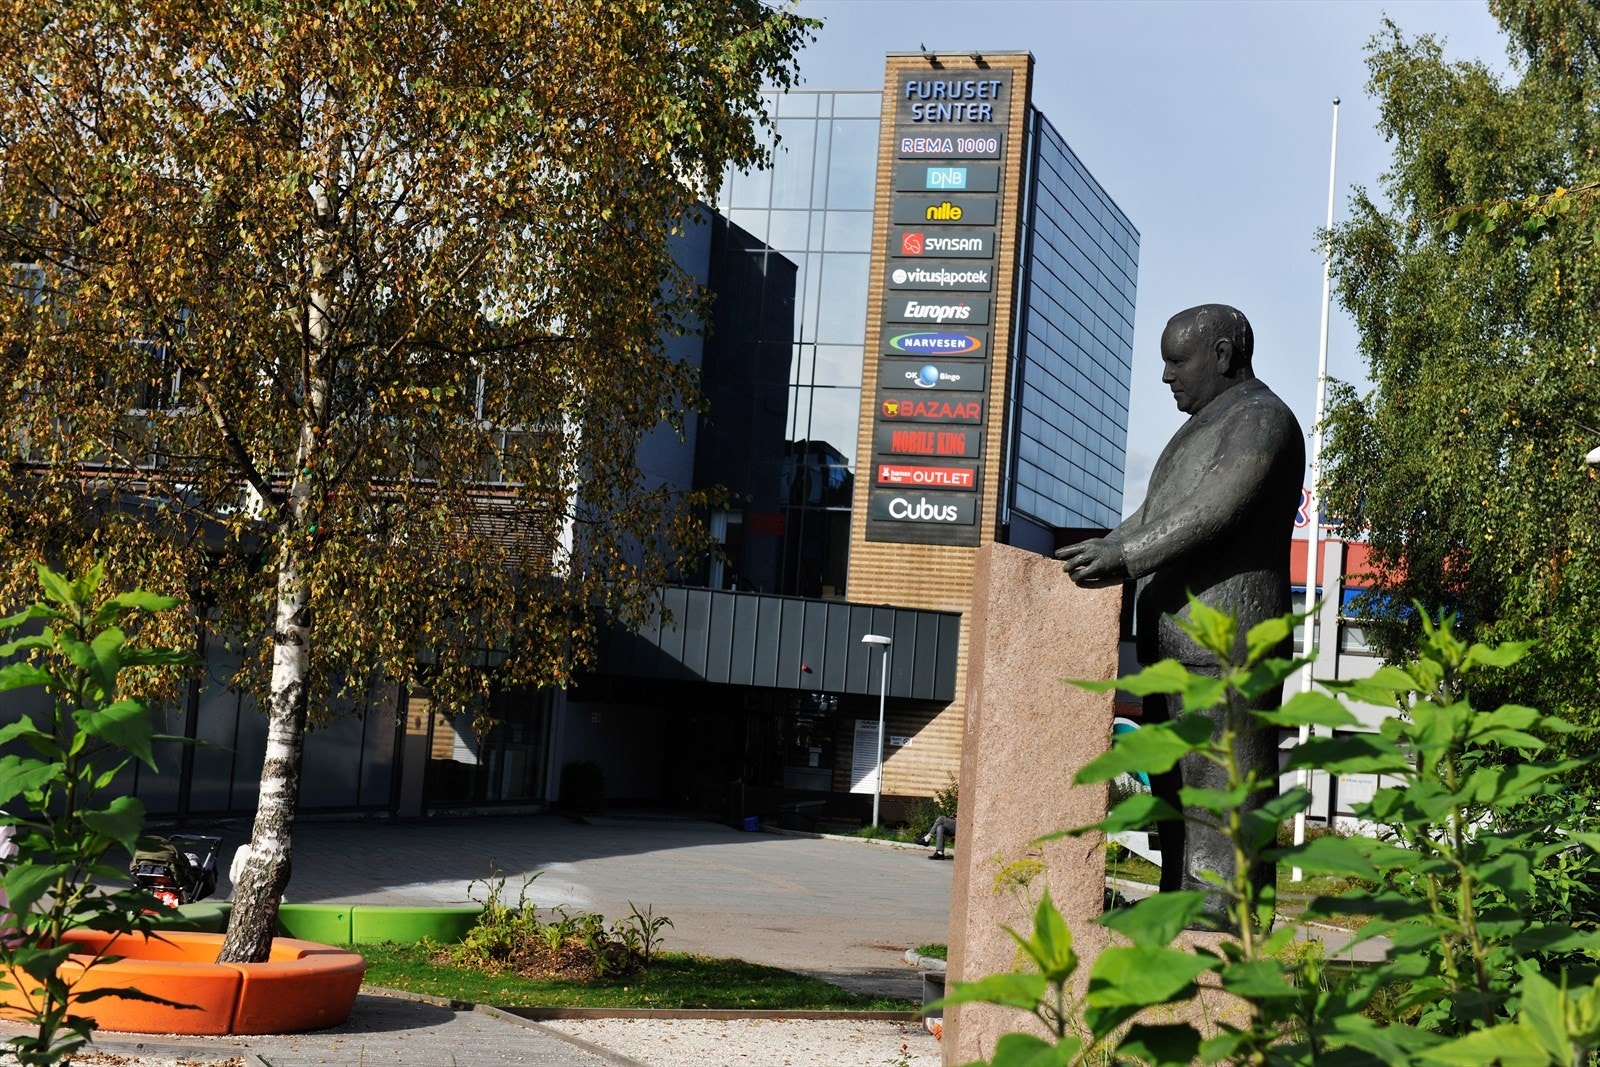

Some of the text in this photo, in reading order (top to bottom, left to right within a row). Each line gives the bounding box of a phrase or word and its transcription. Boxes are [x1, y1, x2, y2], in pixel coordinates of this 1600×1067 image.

[905, 80, 1002, 100] FURUSET
[911, 103, 993, 122] SENTER
[902, 138, 997, 153] REMA 1000
[931, 168, 962, 188] DNB
[925, 202, 963, 221] nille
[904, 301, 971, 323] Europris
[904, 338, 966, 349] NARVESEN
[939, 372, 961, 382] Bingo
[901, 400, 980, 419] BAZAAR
[891, 430, 966, 455] MOBILE KING
[913, 471, 970, 485] OUTLET
[888, 497, 958, 522] Cubus
